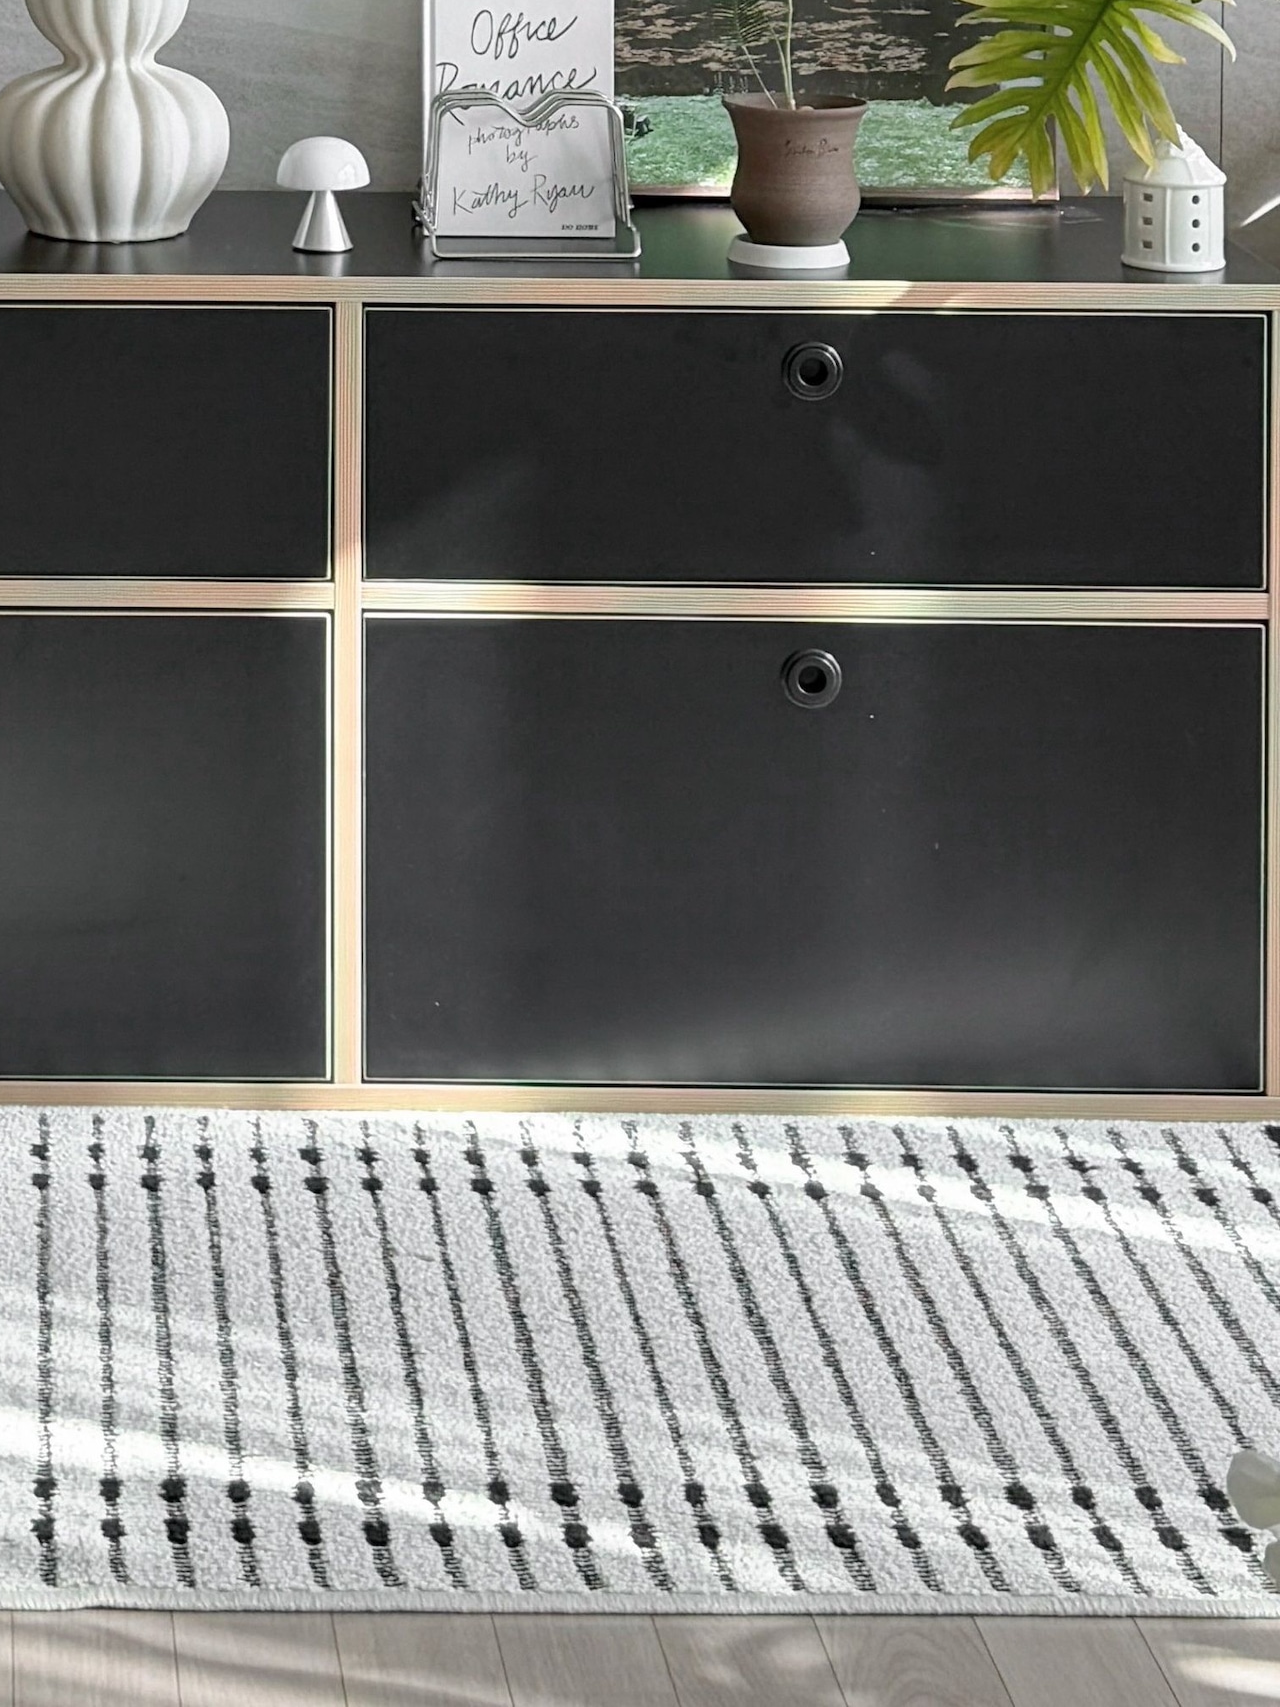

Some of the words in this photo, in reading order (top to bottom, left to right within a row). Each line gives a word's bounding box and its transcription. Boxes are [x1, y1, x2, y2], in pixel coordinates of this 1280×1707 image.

[470, 9, 578, 60] Office
[506, 144, 538, 173] by
[453, 182, 528, 219] Kathy
[530, 173, 596, 214] Ryan
